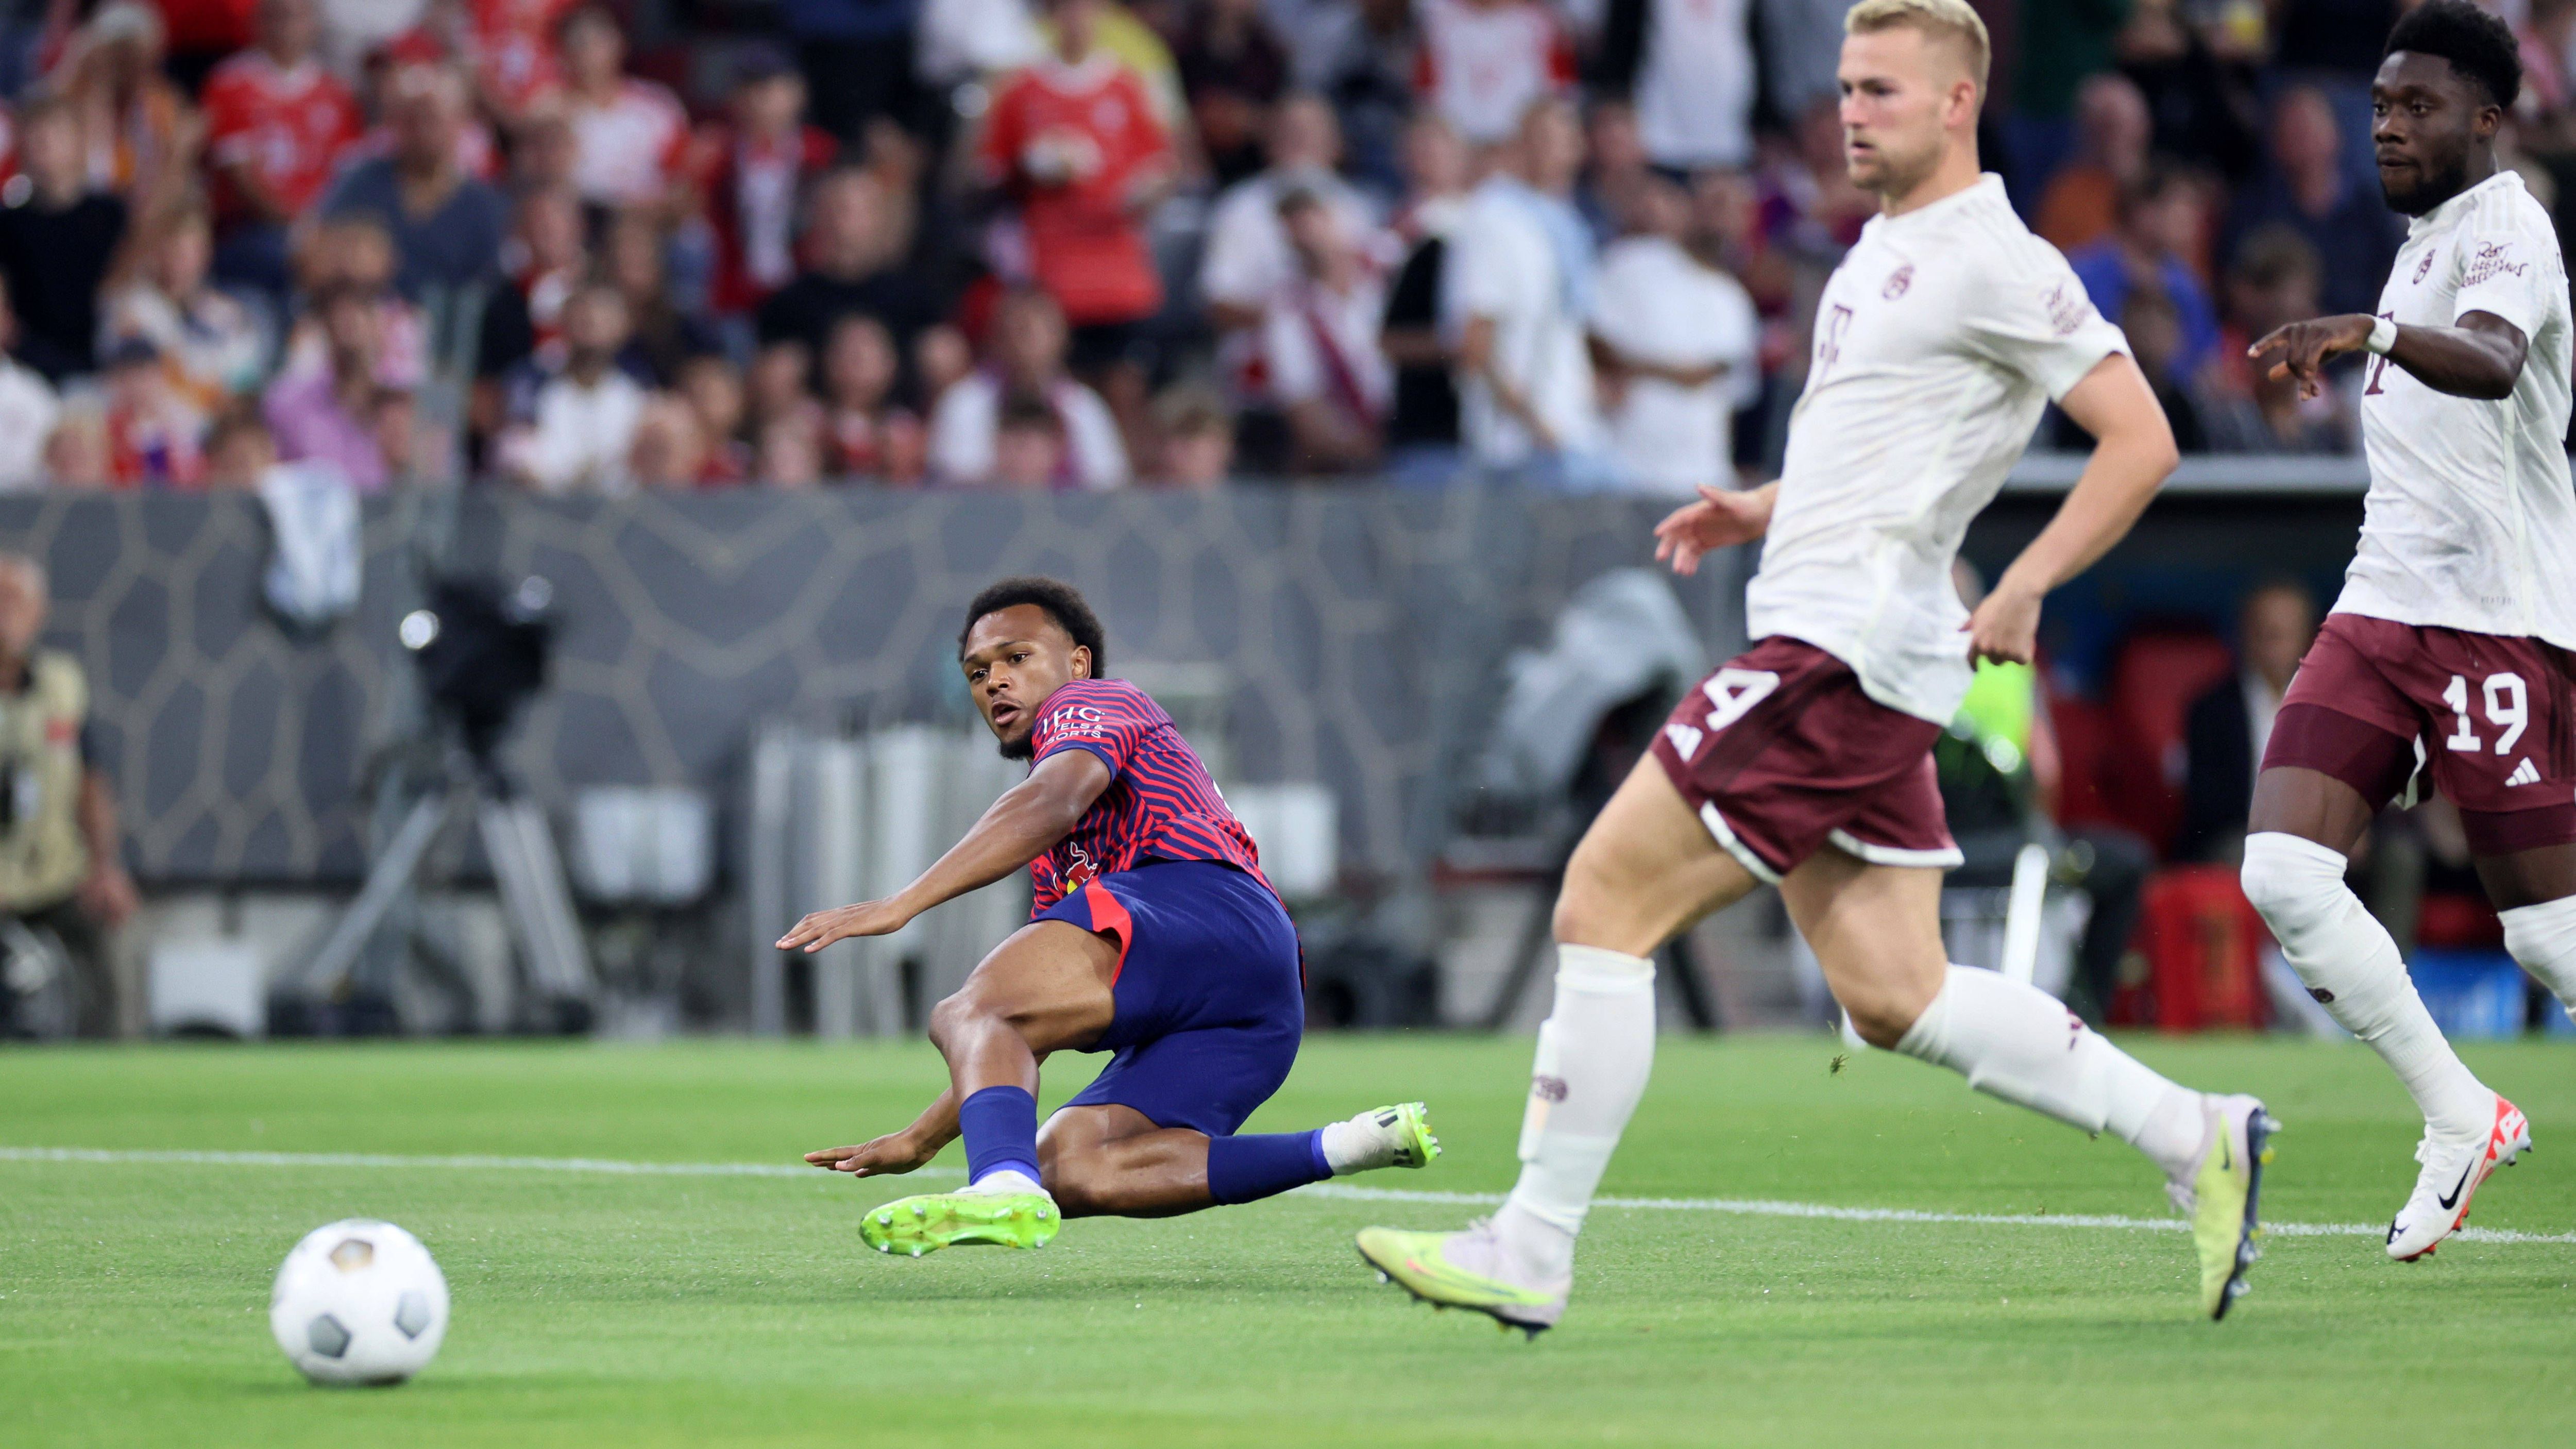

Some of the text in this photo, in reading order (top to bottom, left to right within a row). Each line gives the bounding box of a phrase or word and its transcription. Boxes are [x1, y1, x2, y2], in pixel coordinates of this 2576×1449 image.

[1703, 668, 1781, 732] 4
[2442, 672, 2528, 755] 19
[1043, 706, 1101, 735] IHG
[1054, 722, 1090, 733] TELS
[1042, 730, 1101, 749] SORTS
